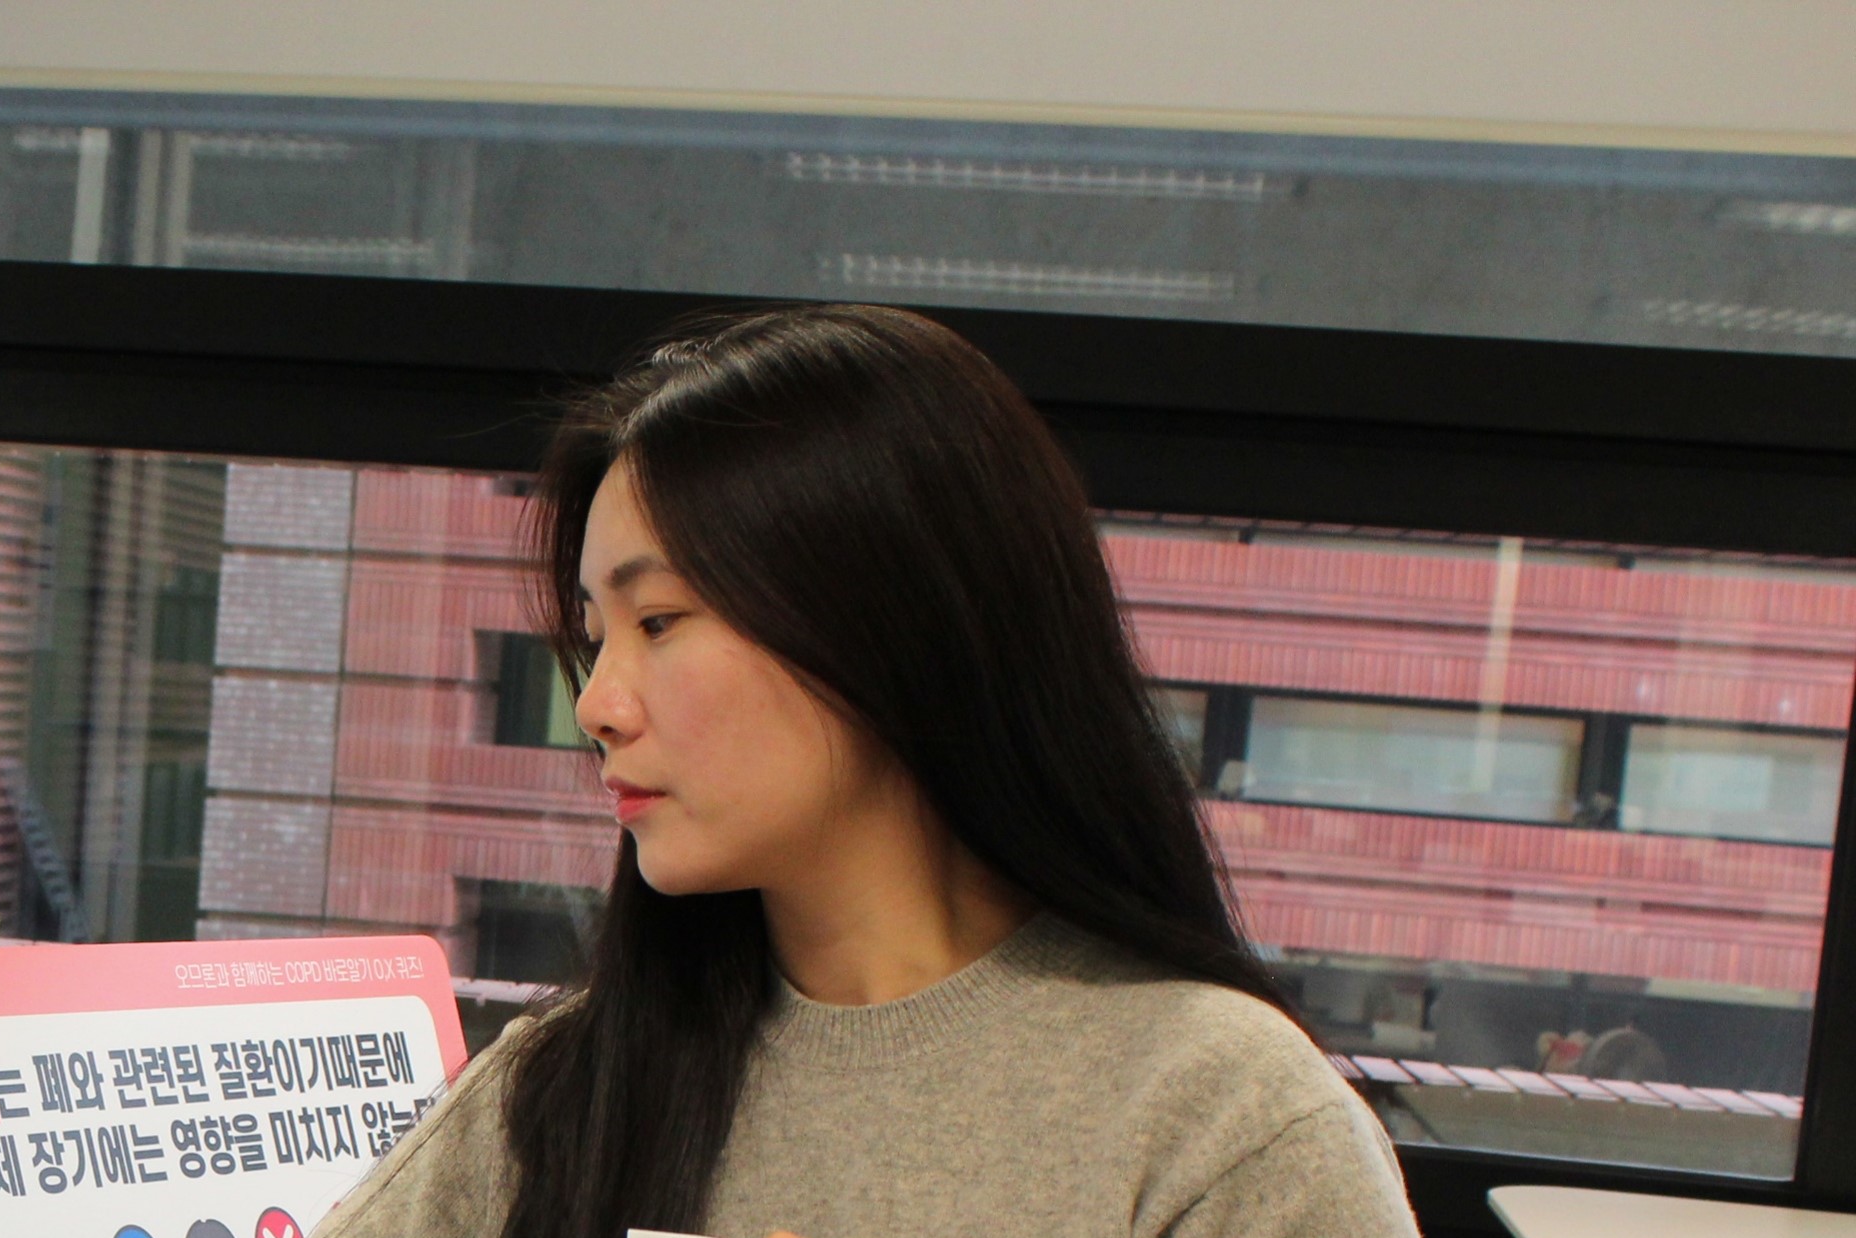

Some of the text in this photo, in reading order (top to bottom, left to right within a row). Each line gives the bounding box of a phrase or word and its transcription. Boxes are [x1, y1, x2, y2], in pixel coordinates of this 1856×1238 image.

[175, 963, 230, 989] 오므론과
[230, 961, 285, 988] 함께하는
[285, 960, 323, 984] COPD
[323, 958, 373, 983] 바로알기
[395, 956, 425, 982] 퀴즈!
[31, 1050, 106, 1114] 폐와
[107, 1044, 211, 1110] 관련된
[210, 1031, 415, 1101] 질환이기때문에
[27, 1123, 169, 1195] 장기에는
[170, 1113, 268, 1180] 영향을
[269, 1104, 360, 1166] 미치지
